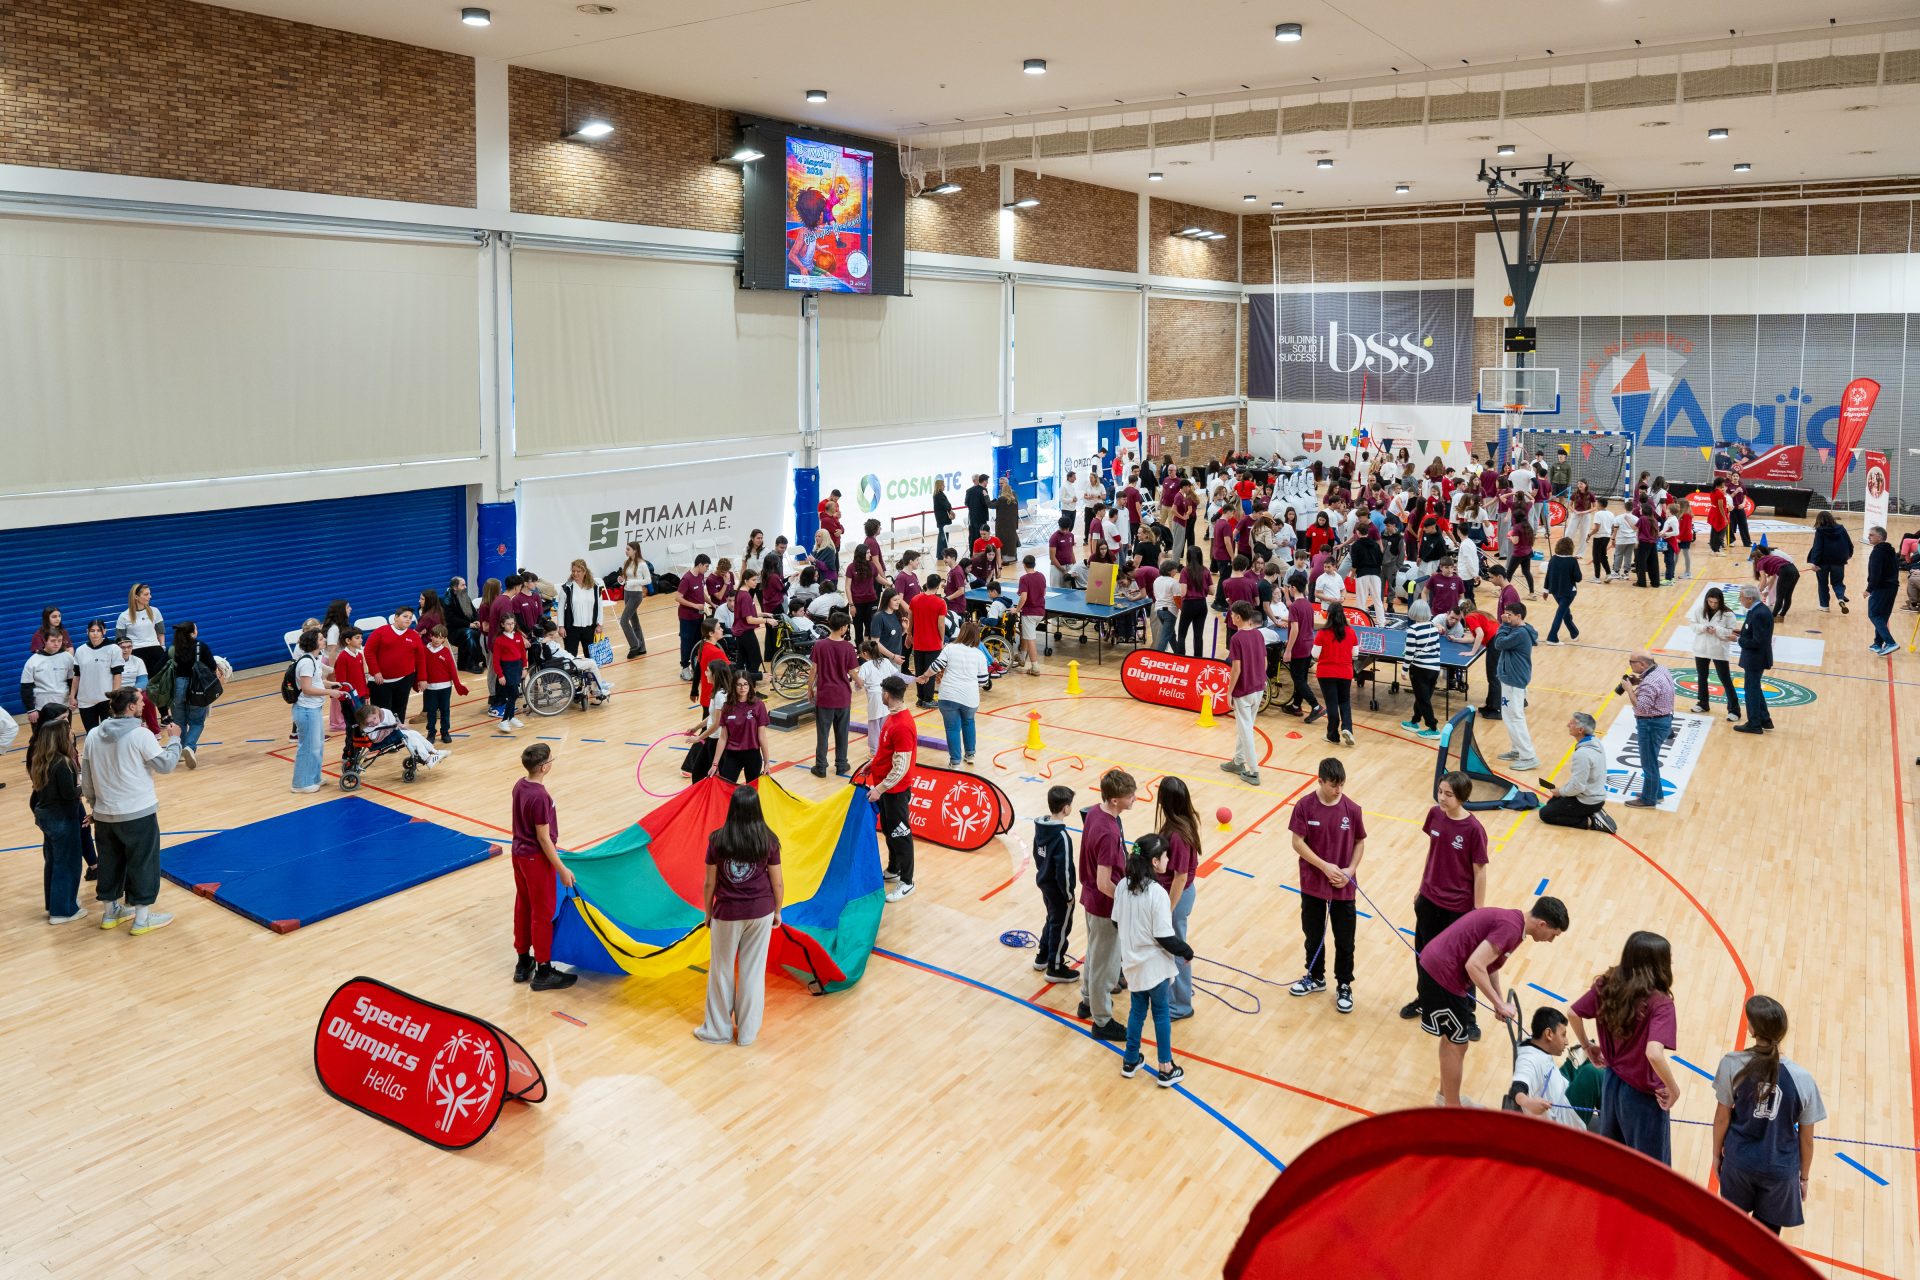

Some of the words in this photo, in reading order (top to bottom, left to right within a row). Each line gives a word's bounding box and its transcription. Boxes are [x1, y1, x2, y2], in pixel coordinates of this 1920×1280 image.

[1279, 336, 1317, 344] BUILDING
[1292, 345, 1317, 353] SOLID
[1279, 353, 1317, 362] SUCCESS
[625, 495, 733, 527] ΜΠΑΛΛΙΑΝ
[625, 520, 696, 545] ΤΕΧΝΙΚΗ
[702, 515, 731, 533] Α.Ε.
[1140, 656, 1190, 674] Special
[1127, 667, 1189, 687] Olympics
[1159, 687, 1186, 700] Hellas
[353, 995, 431, 1043] Special
[327, 1016, 420, 1072] Olympics
[362, 1067, 407, 1101] Hellas
